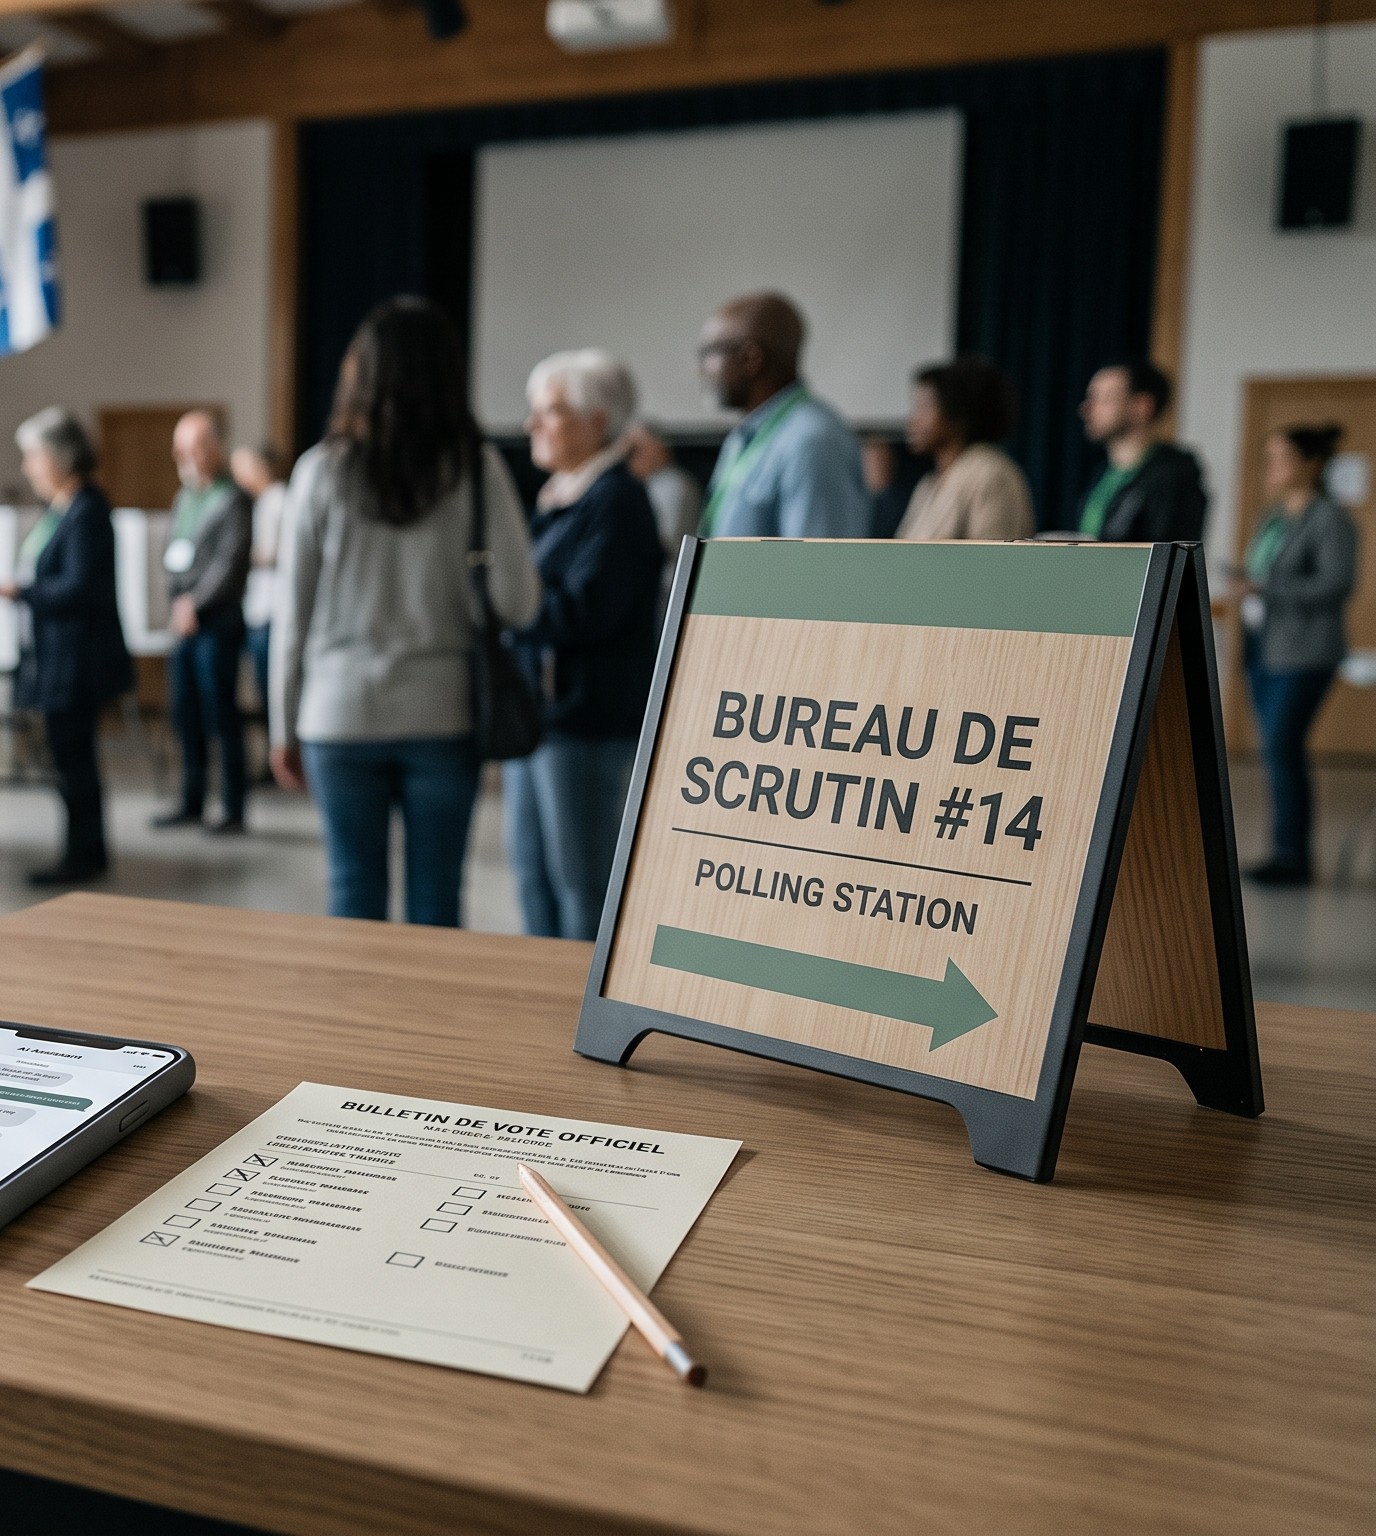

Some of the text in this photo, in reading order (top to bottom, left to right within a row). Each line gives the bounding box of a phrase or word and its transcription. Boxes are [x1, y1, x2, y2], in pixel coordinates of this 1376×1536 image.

[712, 690, 1041, 772] BUREAU DE
[680, 756, 1044, 852] SCRUTIN #14
[694, 858, 979, 936] POLLING STATION
[340, 1101, 451, 1125] BULLETIN
[454, 1117, 488, 1129] DE
[494, 1122, 554, 1139] VOTE
[558, 1132, 665, 1155] OFFICIEL
